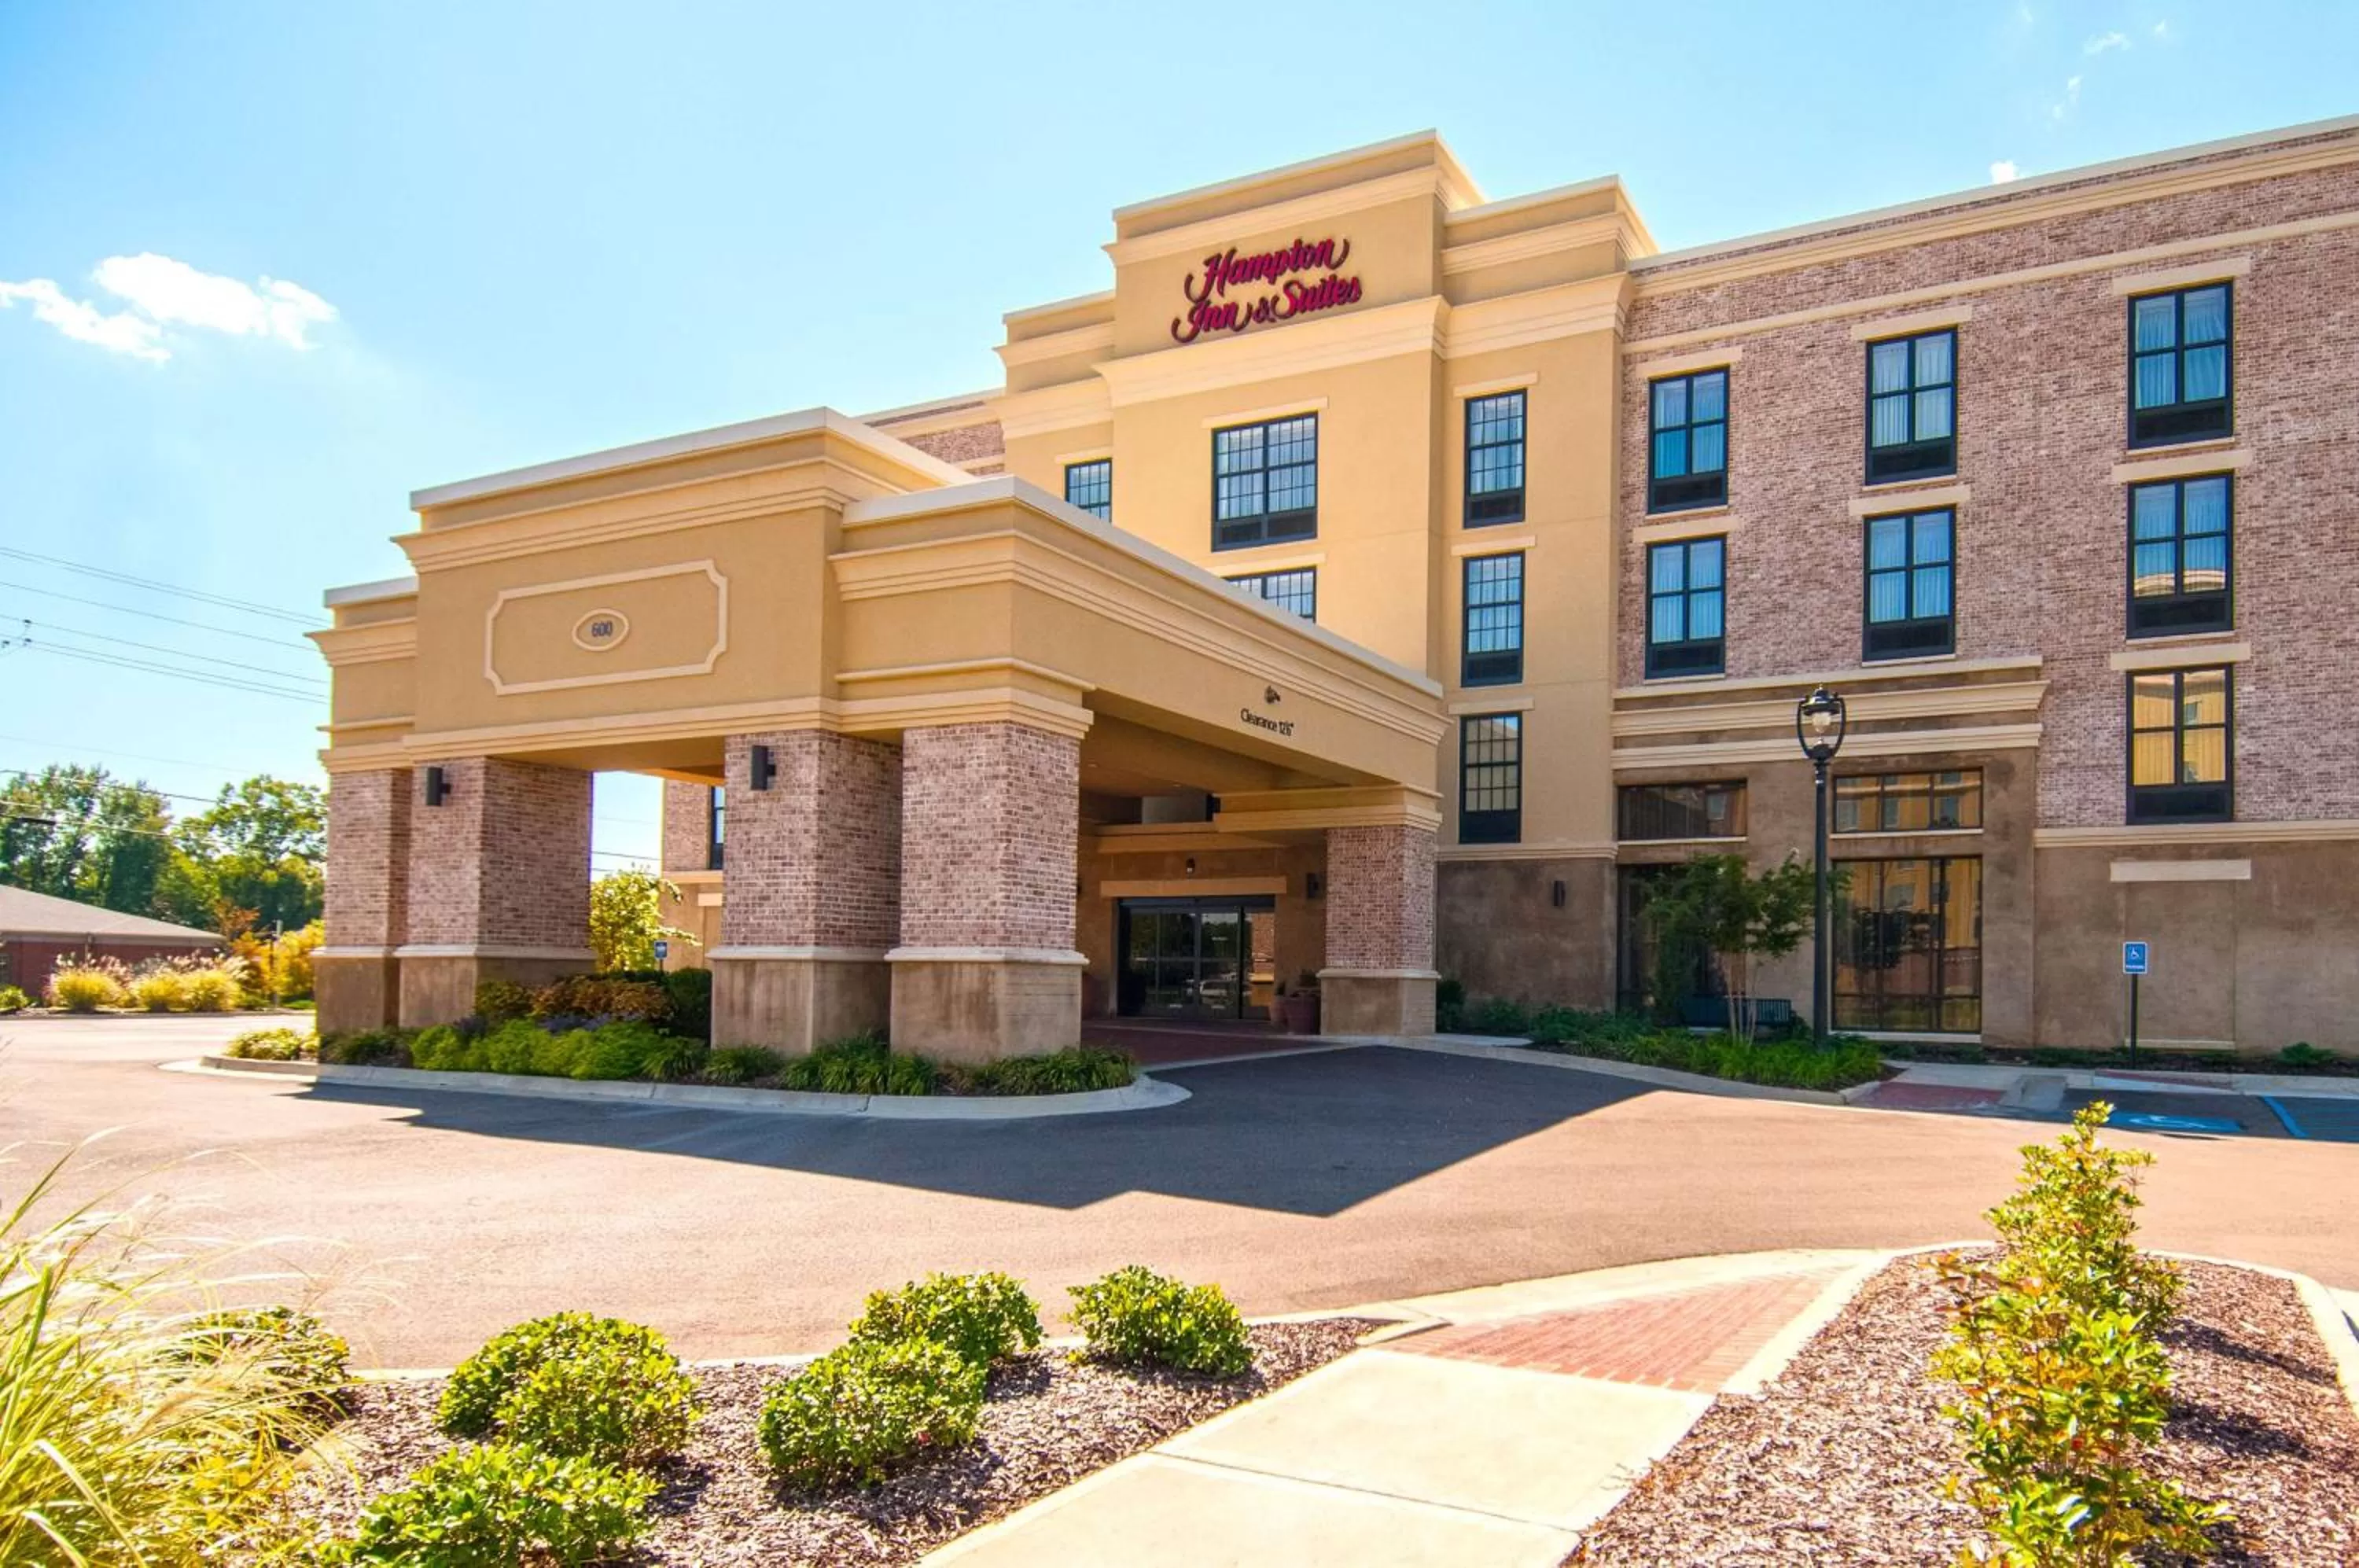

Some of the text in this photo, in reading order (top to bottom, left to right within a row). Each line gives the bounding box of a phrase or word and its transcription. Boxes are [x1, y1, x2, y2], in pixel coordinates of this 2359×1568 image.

[1184, 238, 1350, 304] Hampton
[1171, 273, 1362, 344] Inn & Suites
[591, 620, 613, 638] 600
